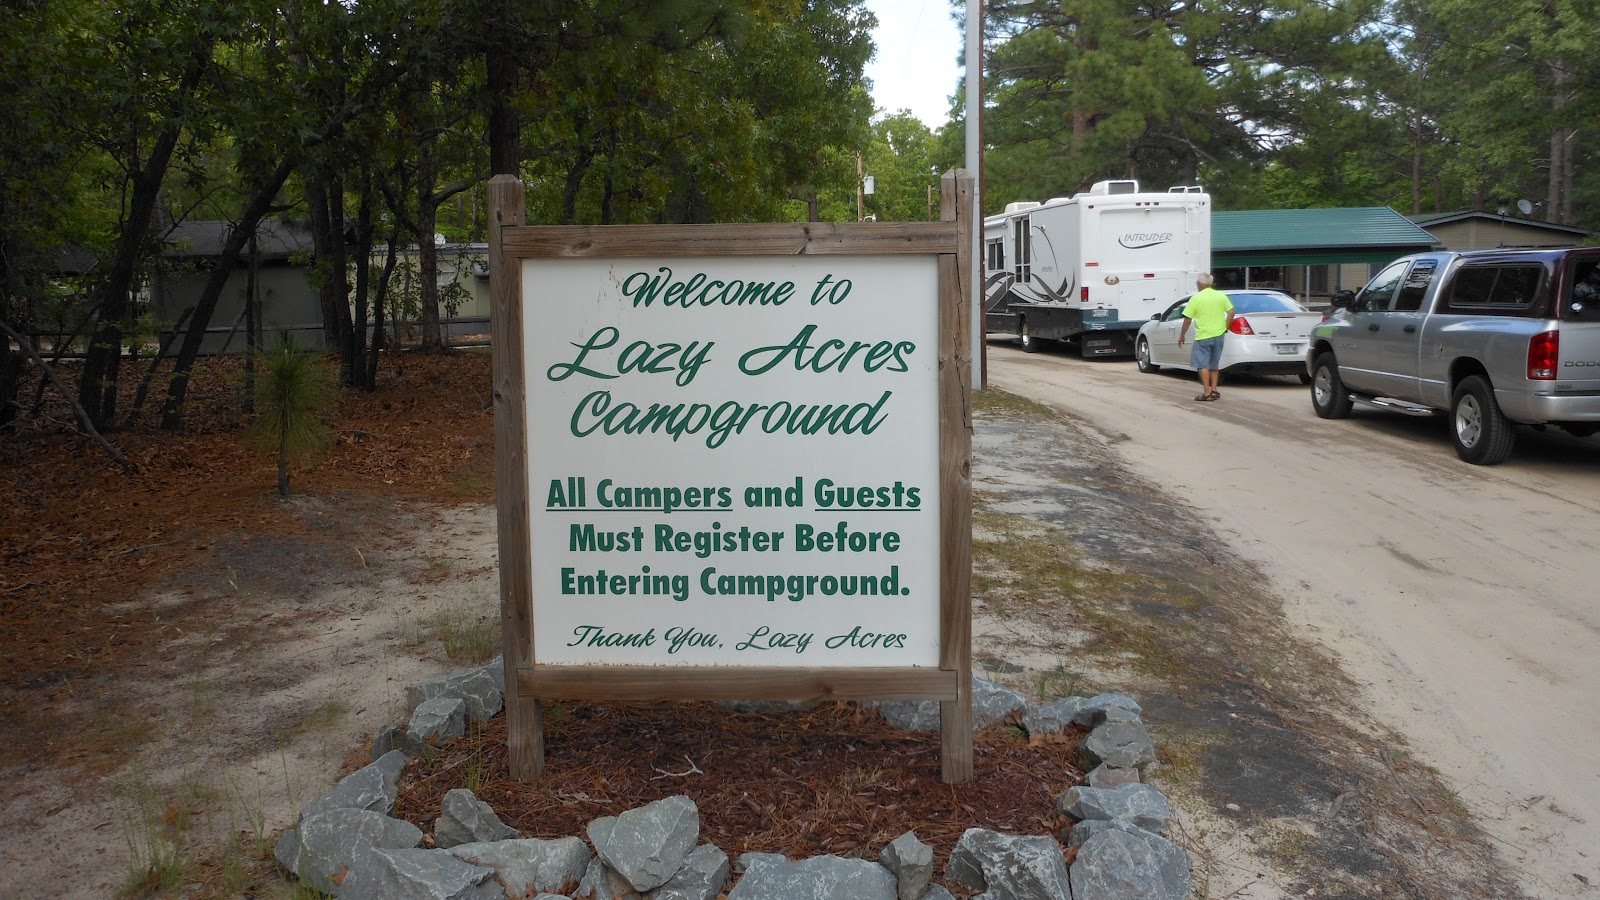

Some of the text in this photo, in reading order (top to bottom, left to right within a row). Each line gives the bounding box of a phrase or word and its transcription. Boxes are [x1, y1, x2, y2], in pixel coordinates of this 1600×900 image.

[1124, 233, 1173, 242] INTRUDER
[622, 267, 852, 309] Welcome to
[547, 324, 917, 387] Lazy Acres
[570, 390, 892, 450] Campground
[546, 476, 922, 514] All Campers and Guests
[569, 521, 901, 559] Must Register Before
[561, 565, 911, 602] Entering Campground.
[567, 625, 656, 649] Thank
[736, 625, 814, 654] Lazy
[825, 625, 908, 650] Acres
